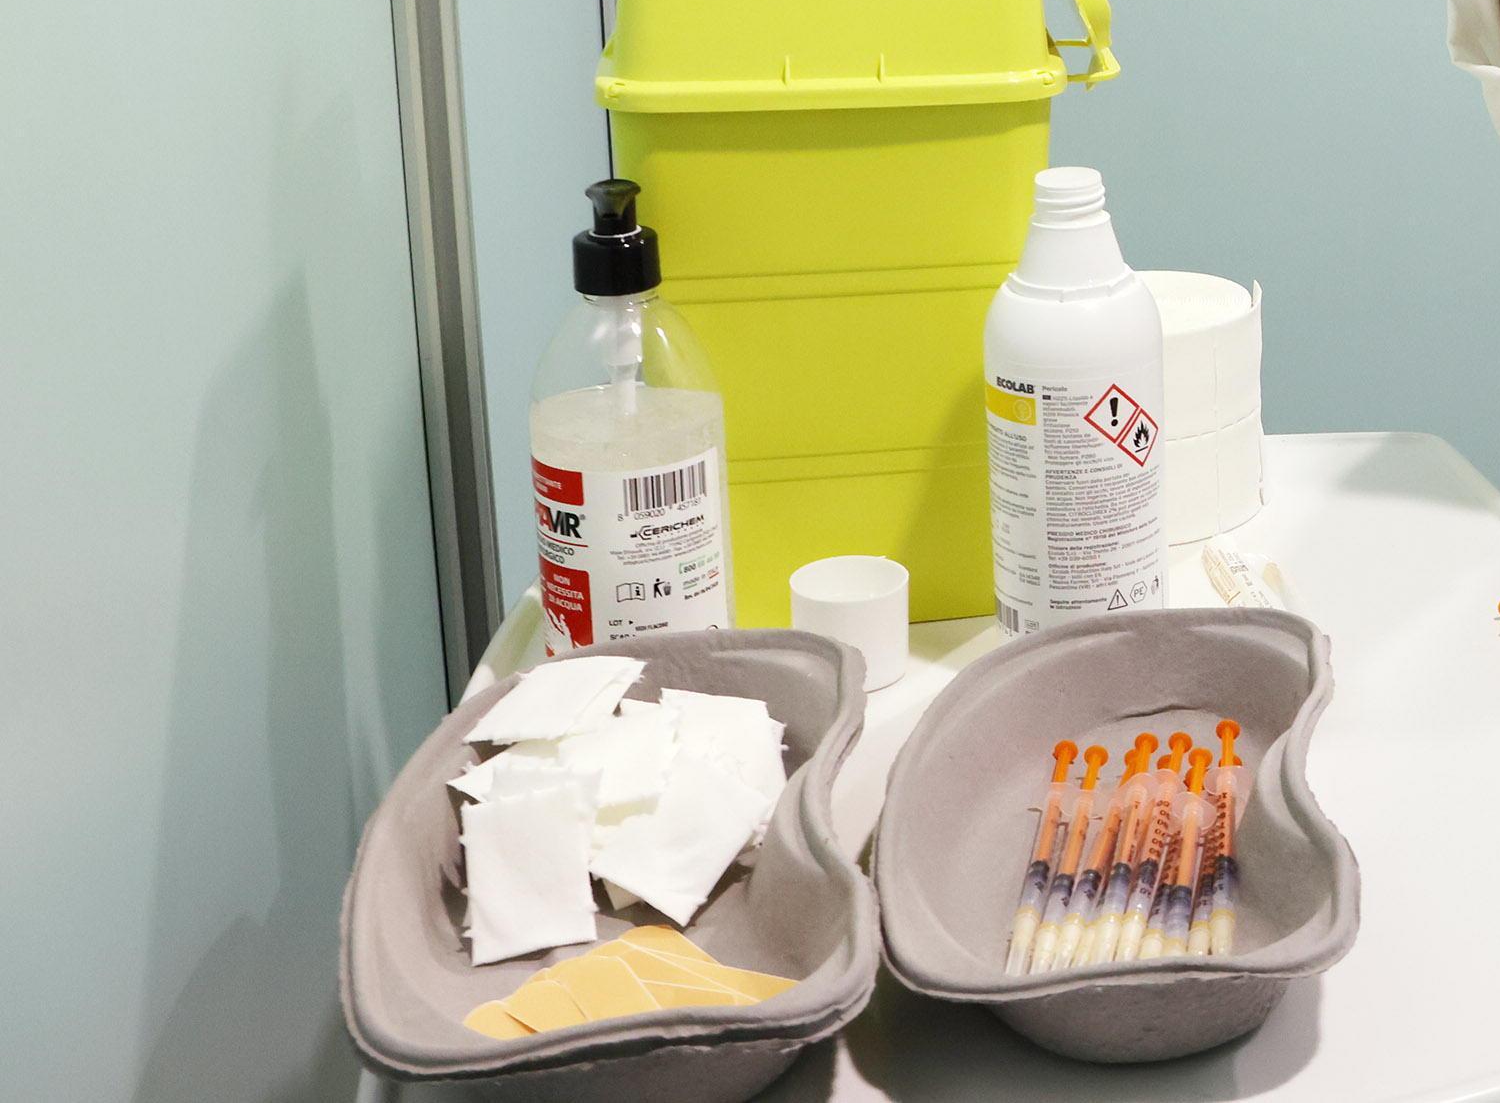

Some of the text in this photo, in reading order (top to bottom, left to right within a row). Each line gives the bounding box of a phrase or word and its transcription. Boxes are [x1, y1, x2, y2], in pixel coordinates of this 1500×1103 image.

[996, 376, 1034, 394] ECOLAB
[617, 514, 624, 522] 8
[643, 514, 704, 537] CERICHEM
[1134, 588, 1144, 598] PE
